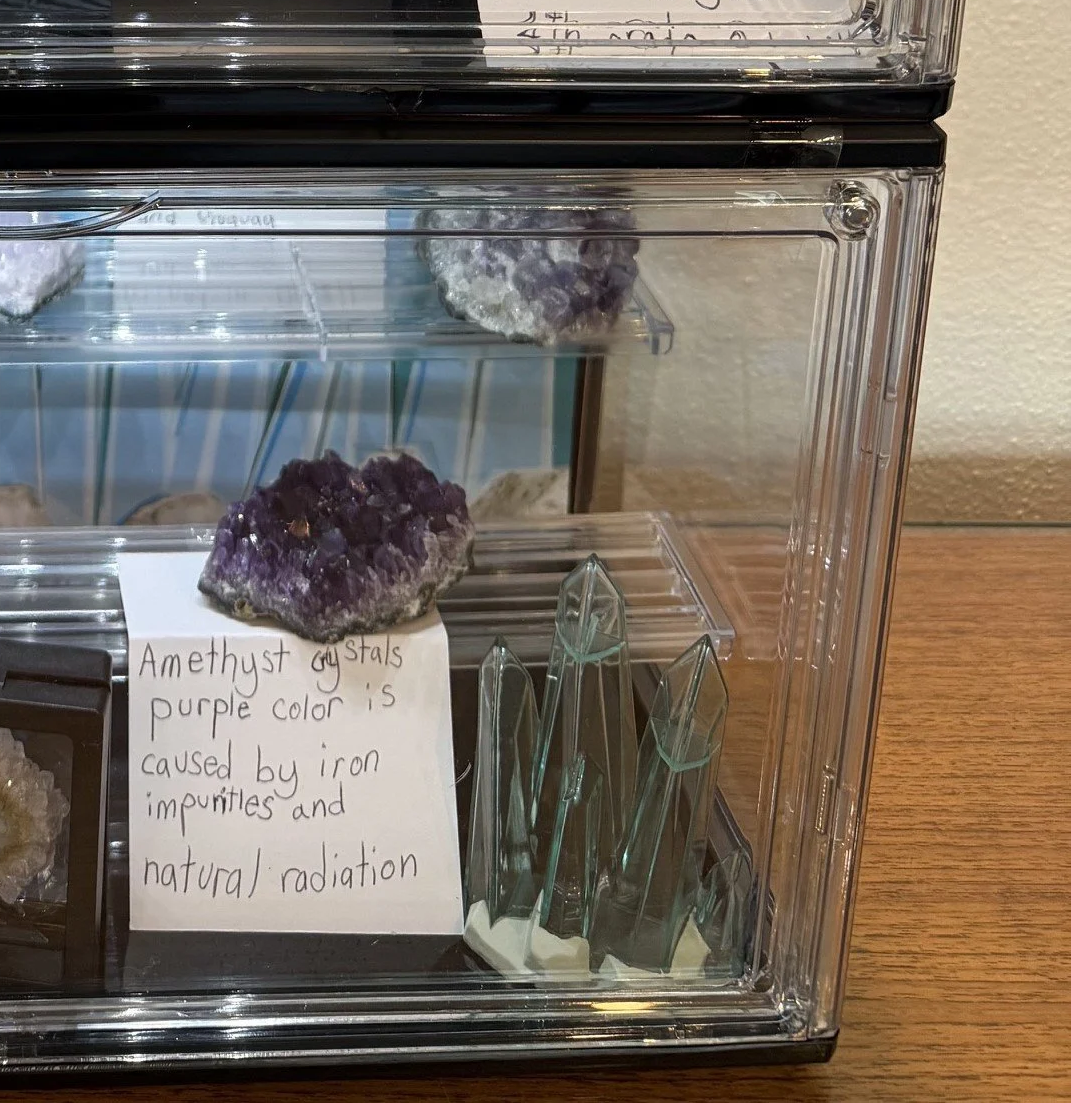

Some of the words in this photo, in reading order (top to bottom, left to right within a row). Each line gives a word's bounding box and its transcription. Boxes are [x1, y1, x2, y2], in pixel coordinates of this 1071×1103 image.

[138, 636, 290, 696] Amethyst
[150, 695, 252, 742] purple
[272, 695, 344, 722] color
[365, 683, 397, 712] is
[141, 739, 232, 781] caused
[256, 744, 299, 799] by
[320, 743, 381, 778] iron
[291, 781, 346, 821] and
[143, 845, 262, 899] natural
[280, 841, 418, 894] radiation
